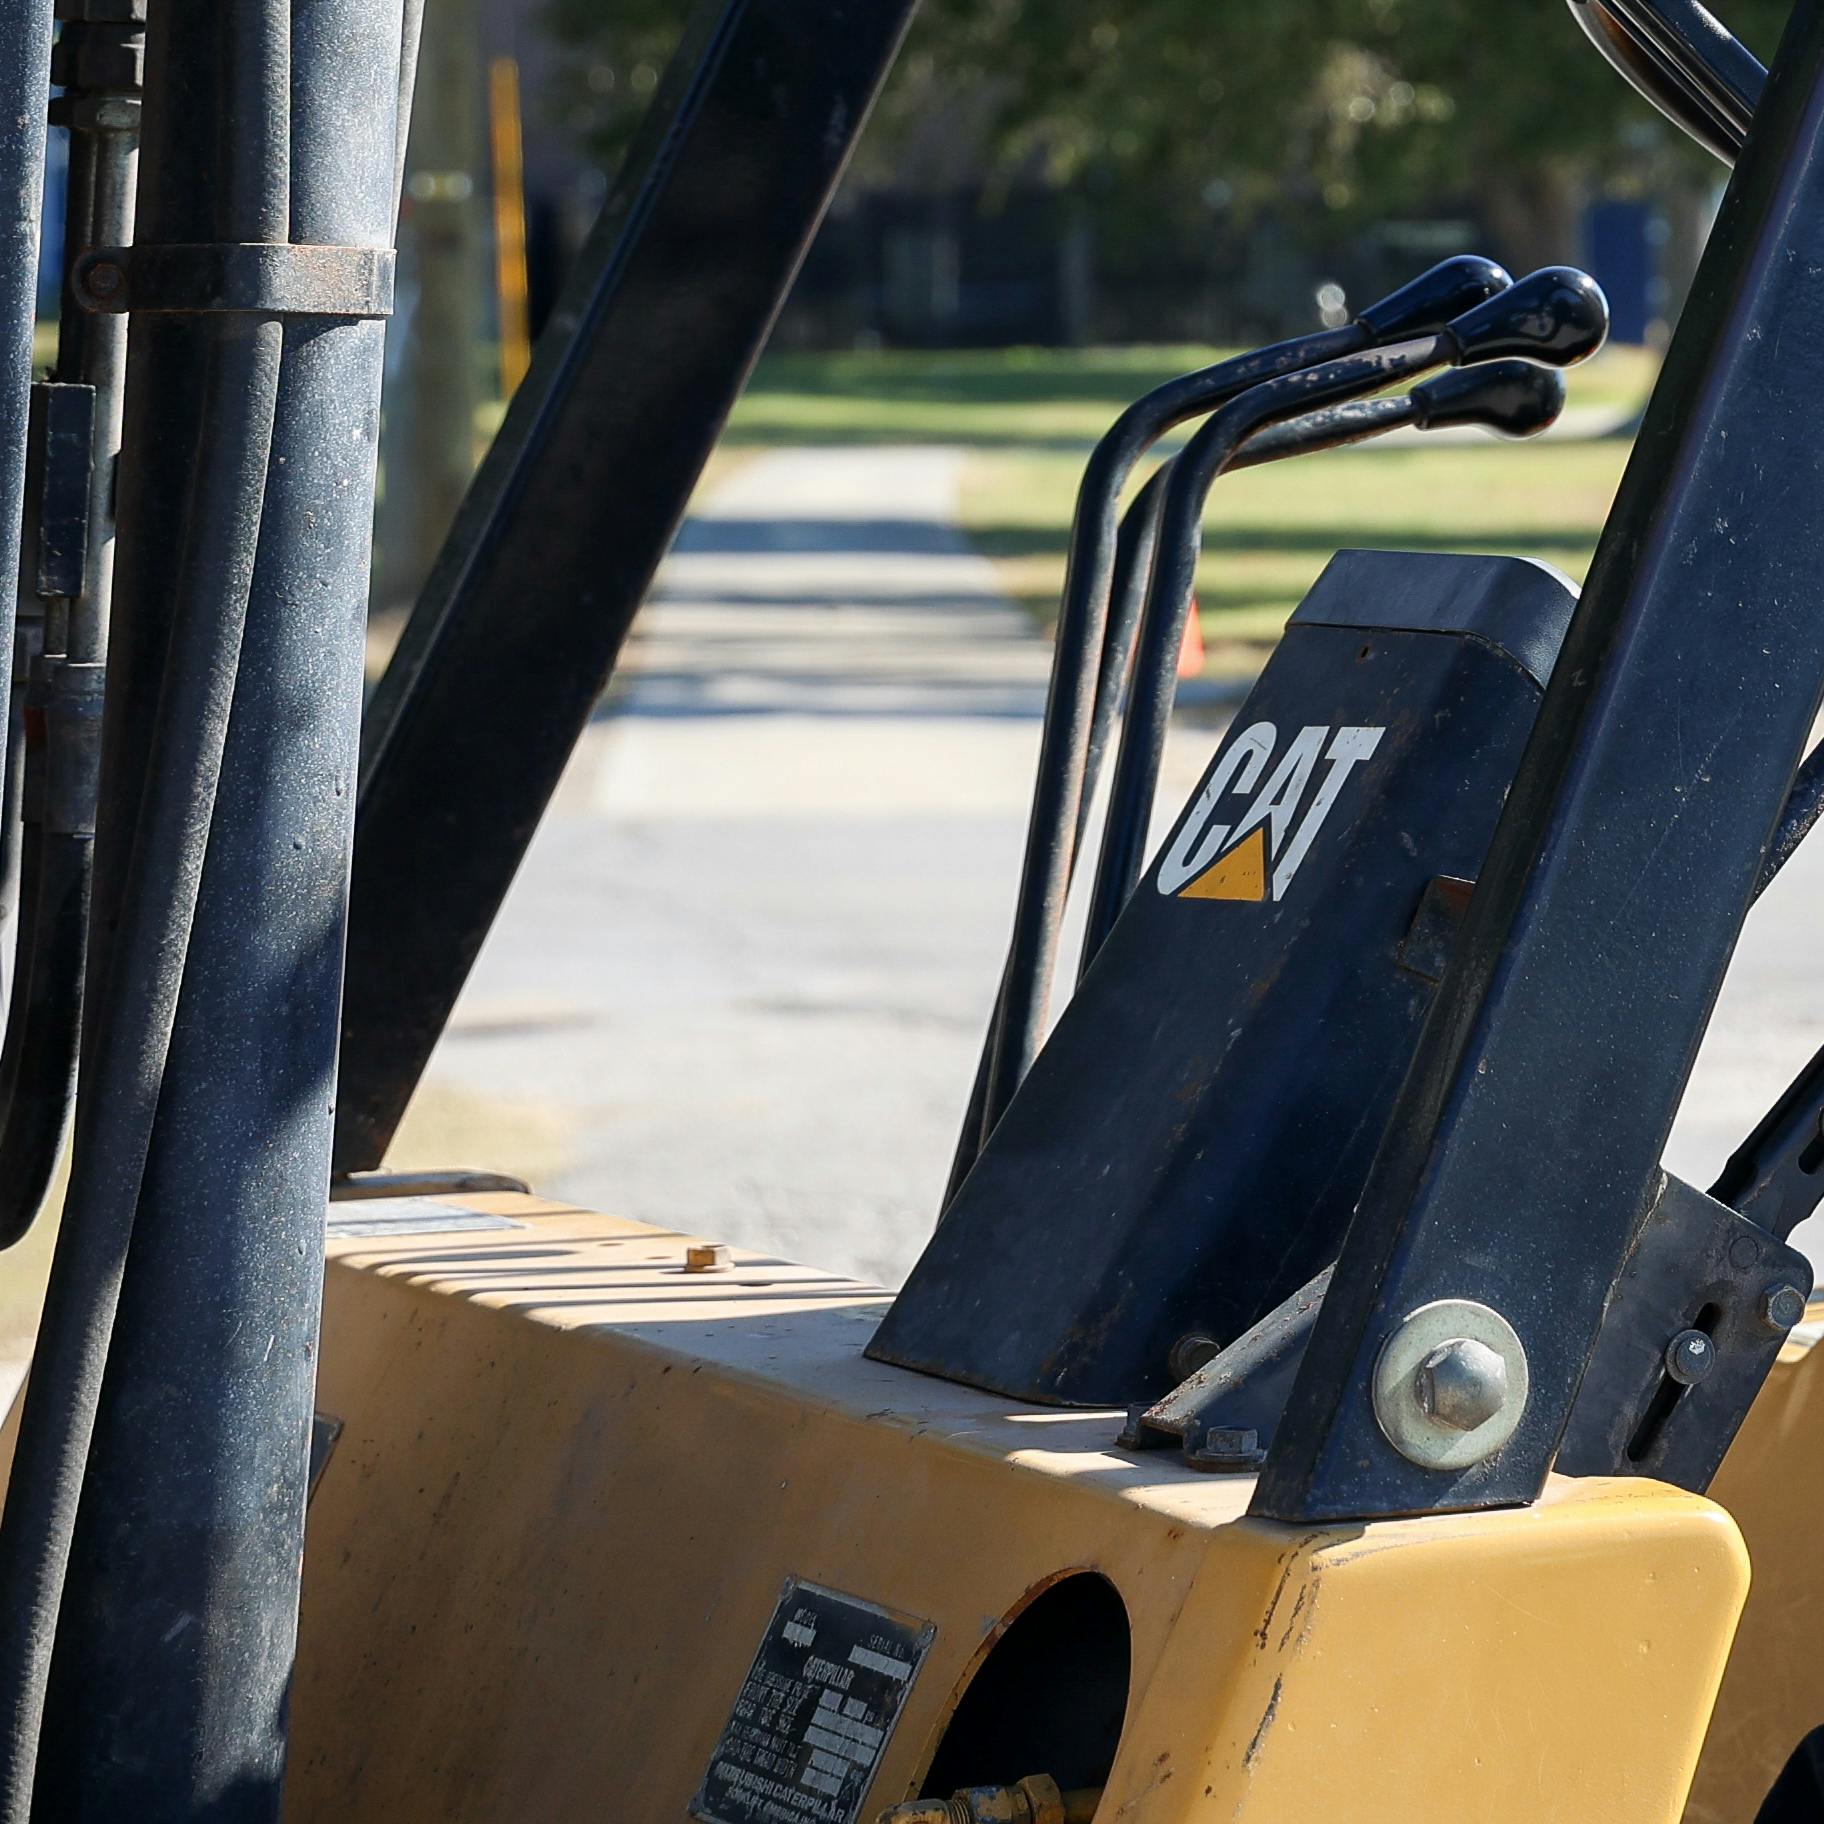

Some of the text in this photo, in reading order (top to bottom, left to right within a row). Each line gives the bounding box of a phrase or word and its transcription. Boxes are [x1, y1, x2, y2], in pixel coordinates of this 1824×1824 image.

[1157, 721, 1386, 901] CAT
[803, 1655, 855, 1691] CATERPILLAR
[774, 1783, 845, 1823] CATERPILLAR
